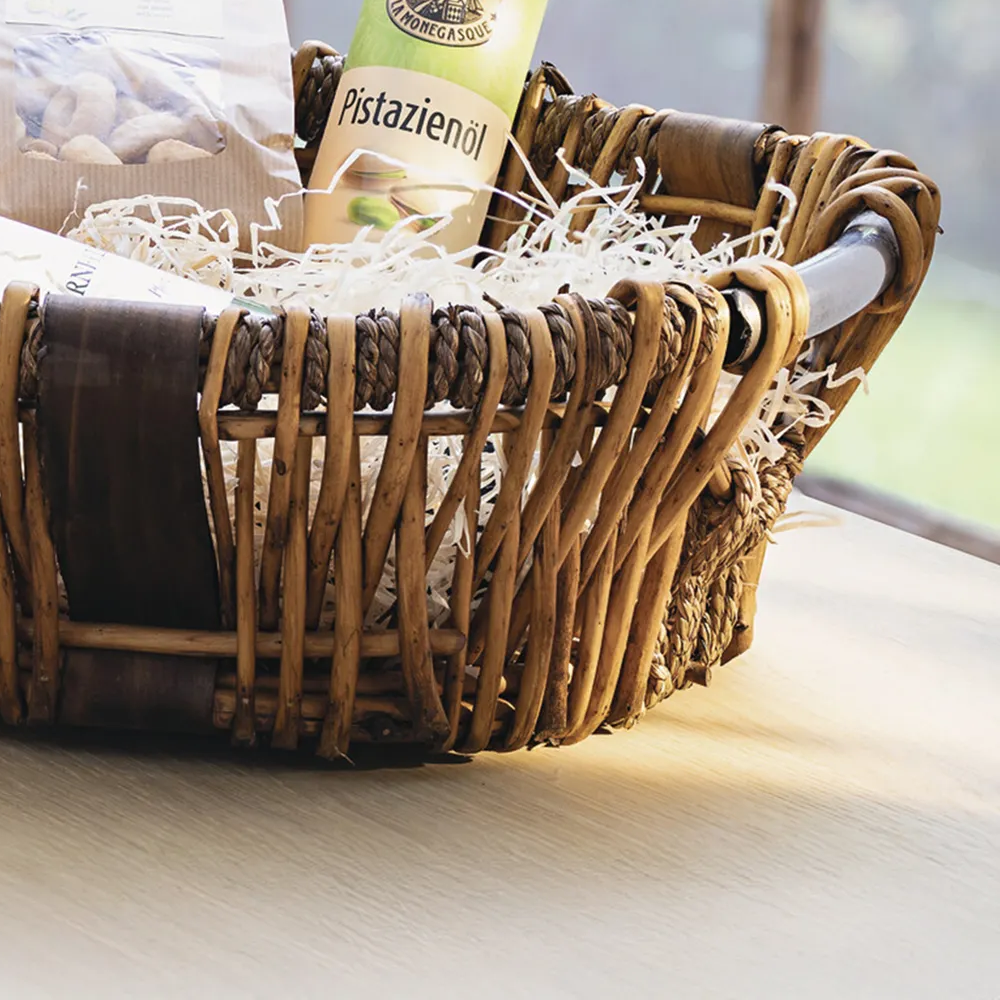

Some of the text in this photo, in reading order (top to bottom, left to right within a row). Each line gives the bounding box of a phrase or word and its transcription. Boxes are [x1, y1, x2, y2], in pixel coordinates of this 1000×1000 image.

[391, 0, 492, 42] LA MONEGASQUE
[338, 87, 488, 161] Pistazienöl
